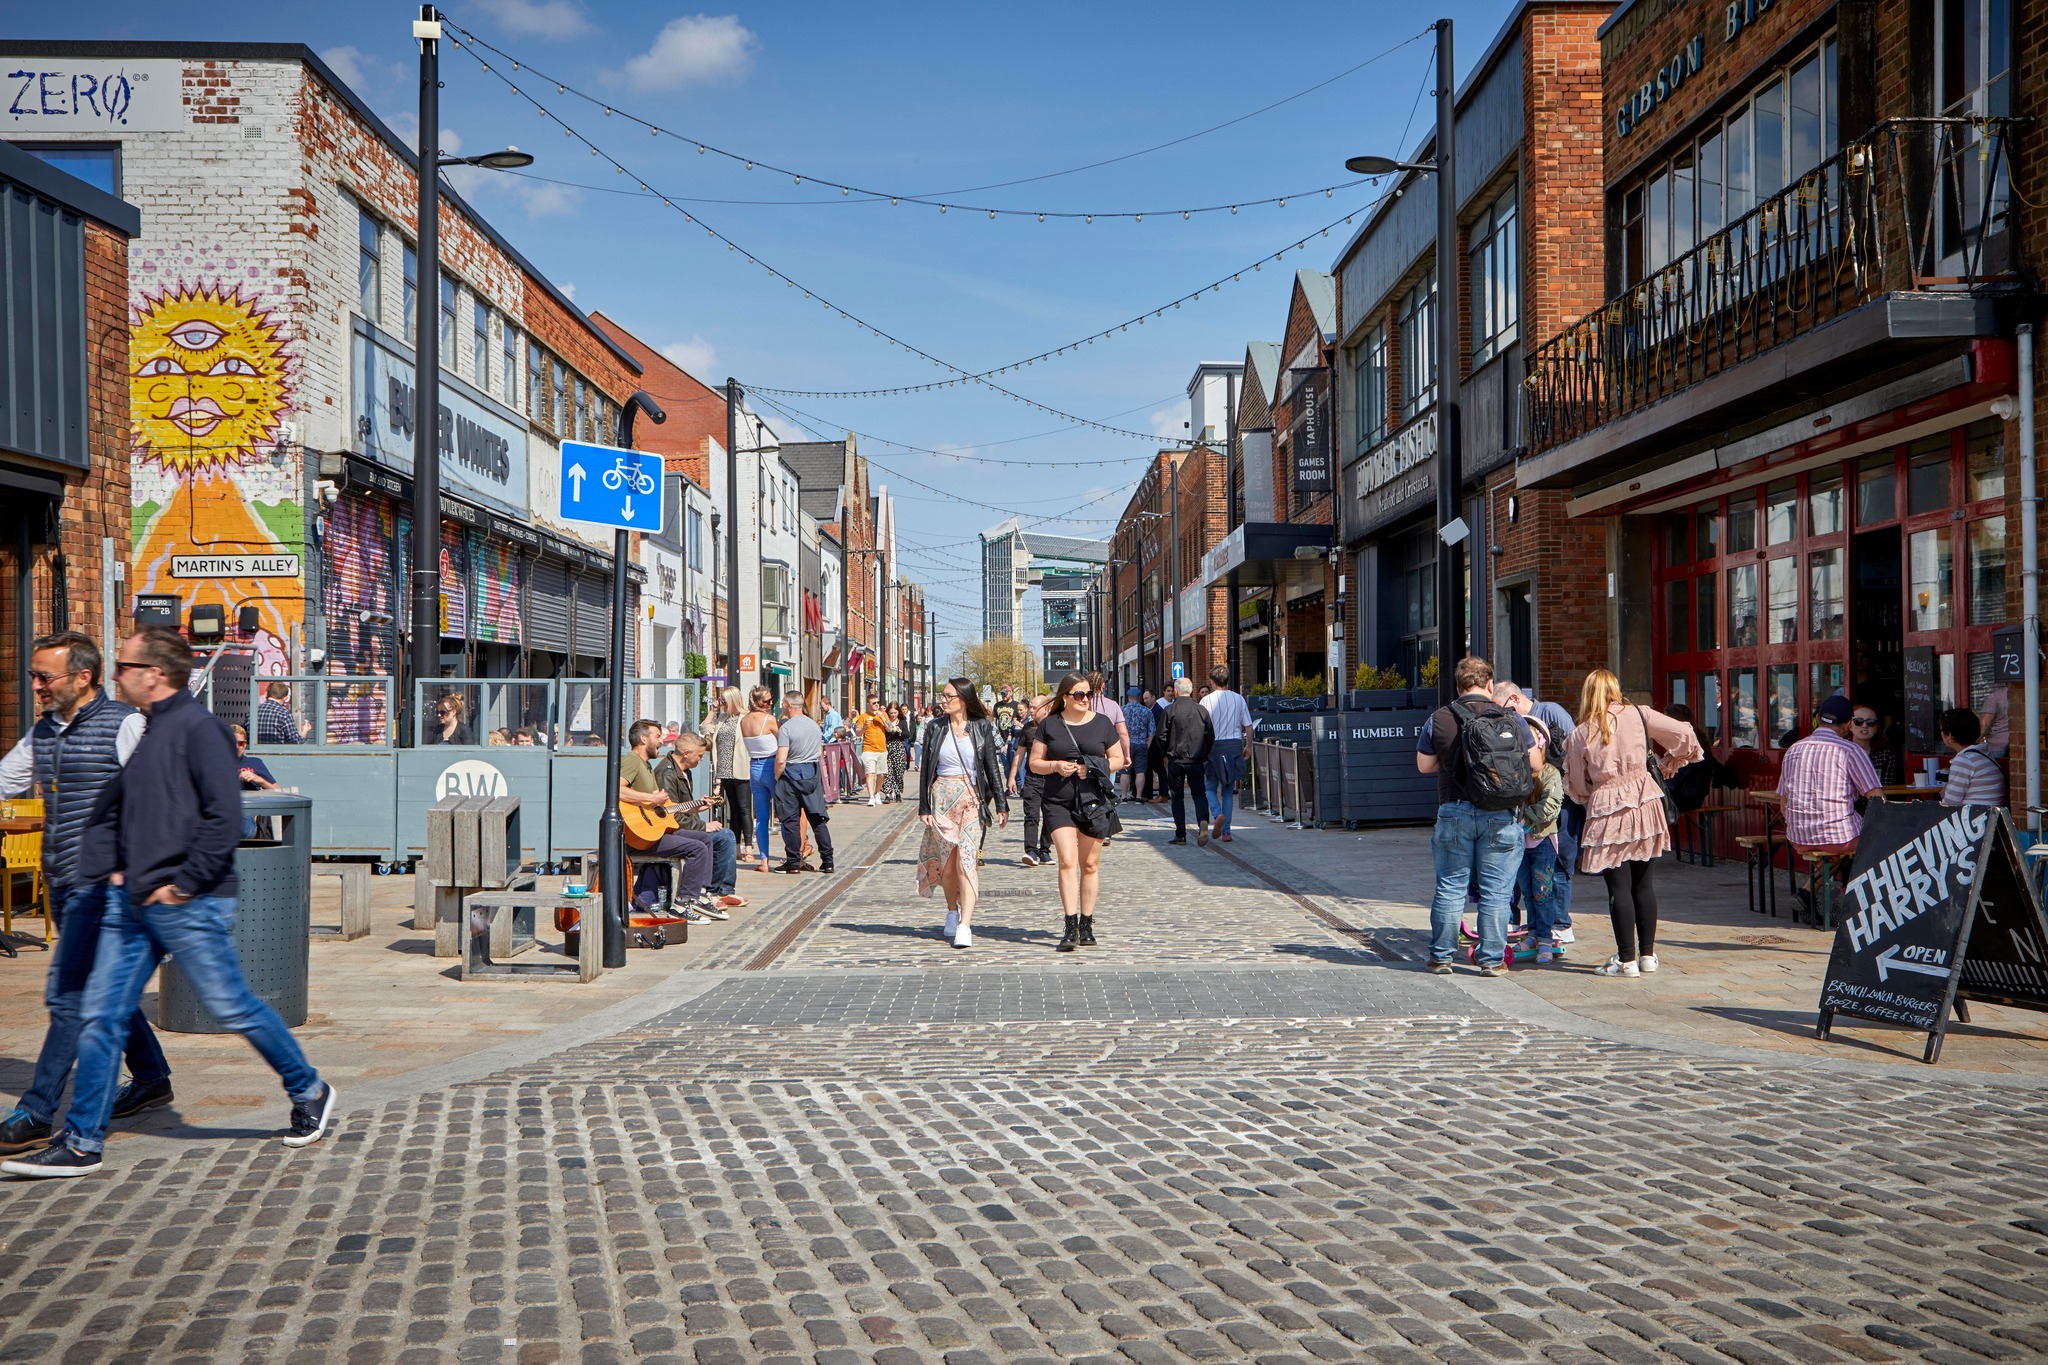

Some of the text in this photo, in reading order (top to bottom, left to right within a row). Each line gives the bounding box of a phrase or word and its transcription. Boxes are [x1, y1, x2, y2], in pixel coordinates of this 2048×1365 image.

[1616, 34, 1704, 138] GIBSON
[1305, 386, 1316, 446] TAPHOUSE
[456, 413, 510, 481] WHITES
[1299, 457, 1325, 467] GAMES
[1355, 440, 1399, 500] HUMBER
[1399, 419, 1430, 474] FISH
[1299, 470, 1326, 480] ROOM
[177, 559, 293, 573] MARTIN'S ALLEY
[160, 607, 171, 615] 2B
[2000, 653, 2021, 675] 73
[1257, 723, 1292, 732] HUMBER
[1352, 727, 1404, 739] HUMBER
[445, 772, 499, 797] BW
[1845, 804, 1988, 911] THIEVING
[1846, 846, 1977, 953] HARRY'S
[1903, 945, 1946, 965] OPEN
[1864, 1004, 1899, 1019] COFFEE
[1908, 1014, 1935, 1026] STUFF
[1895, 994, 1939, 1014] BURGERS
